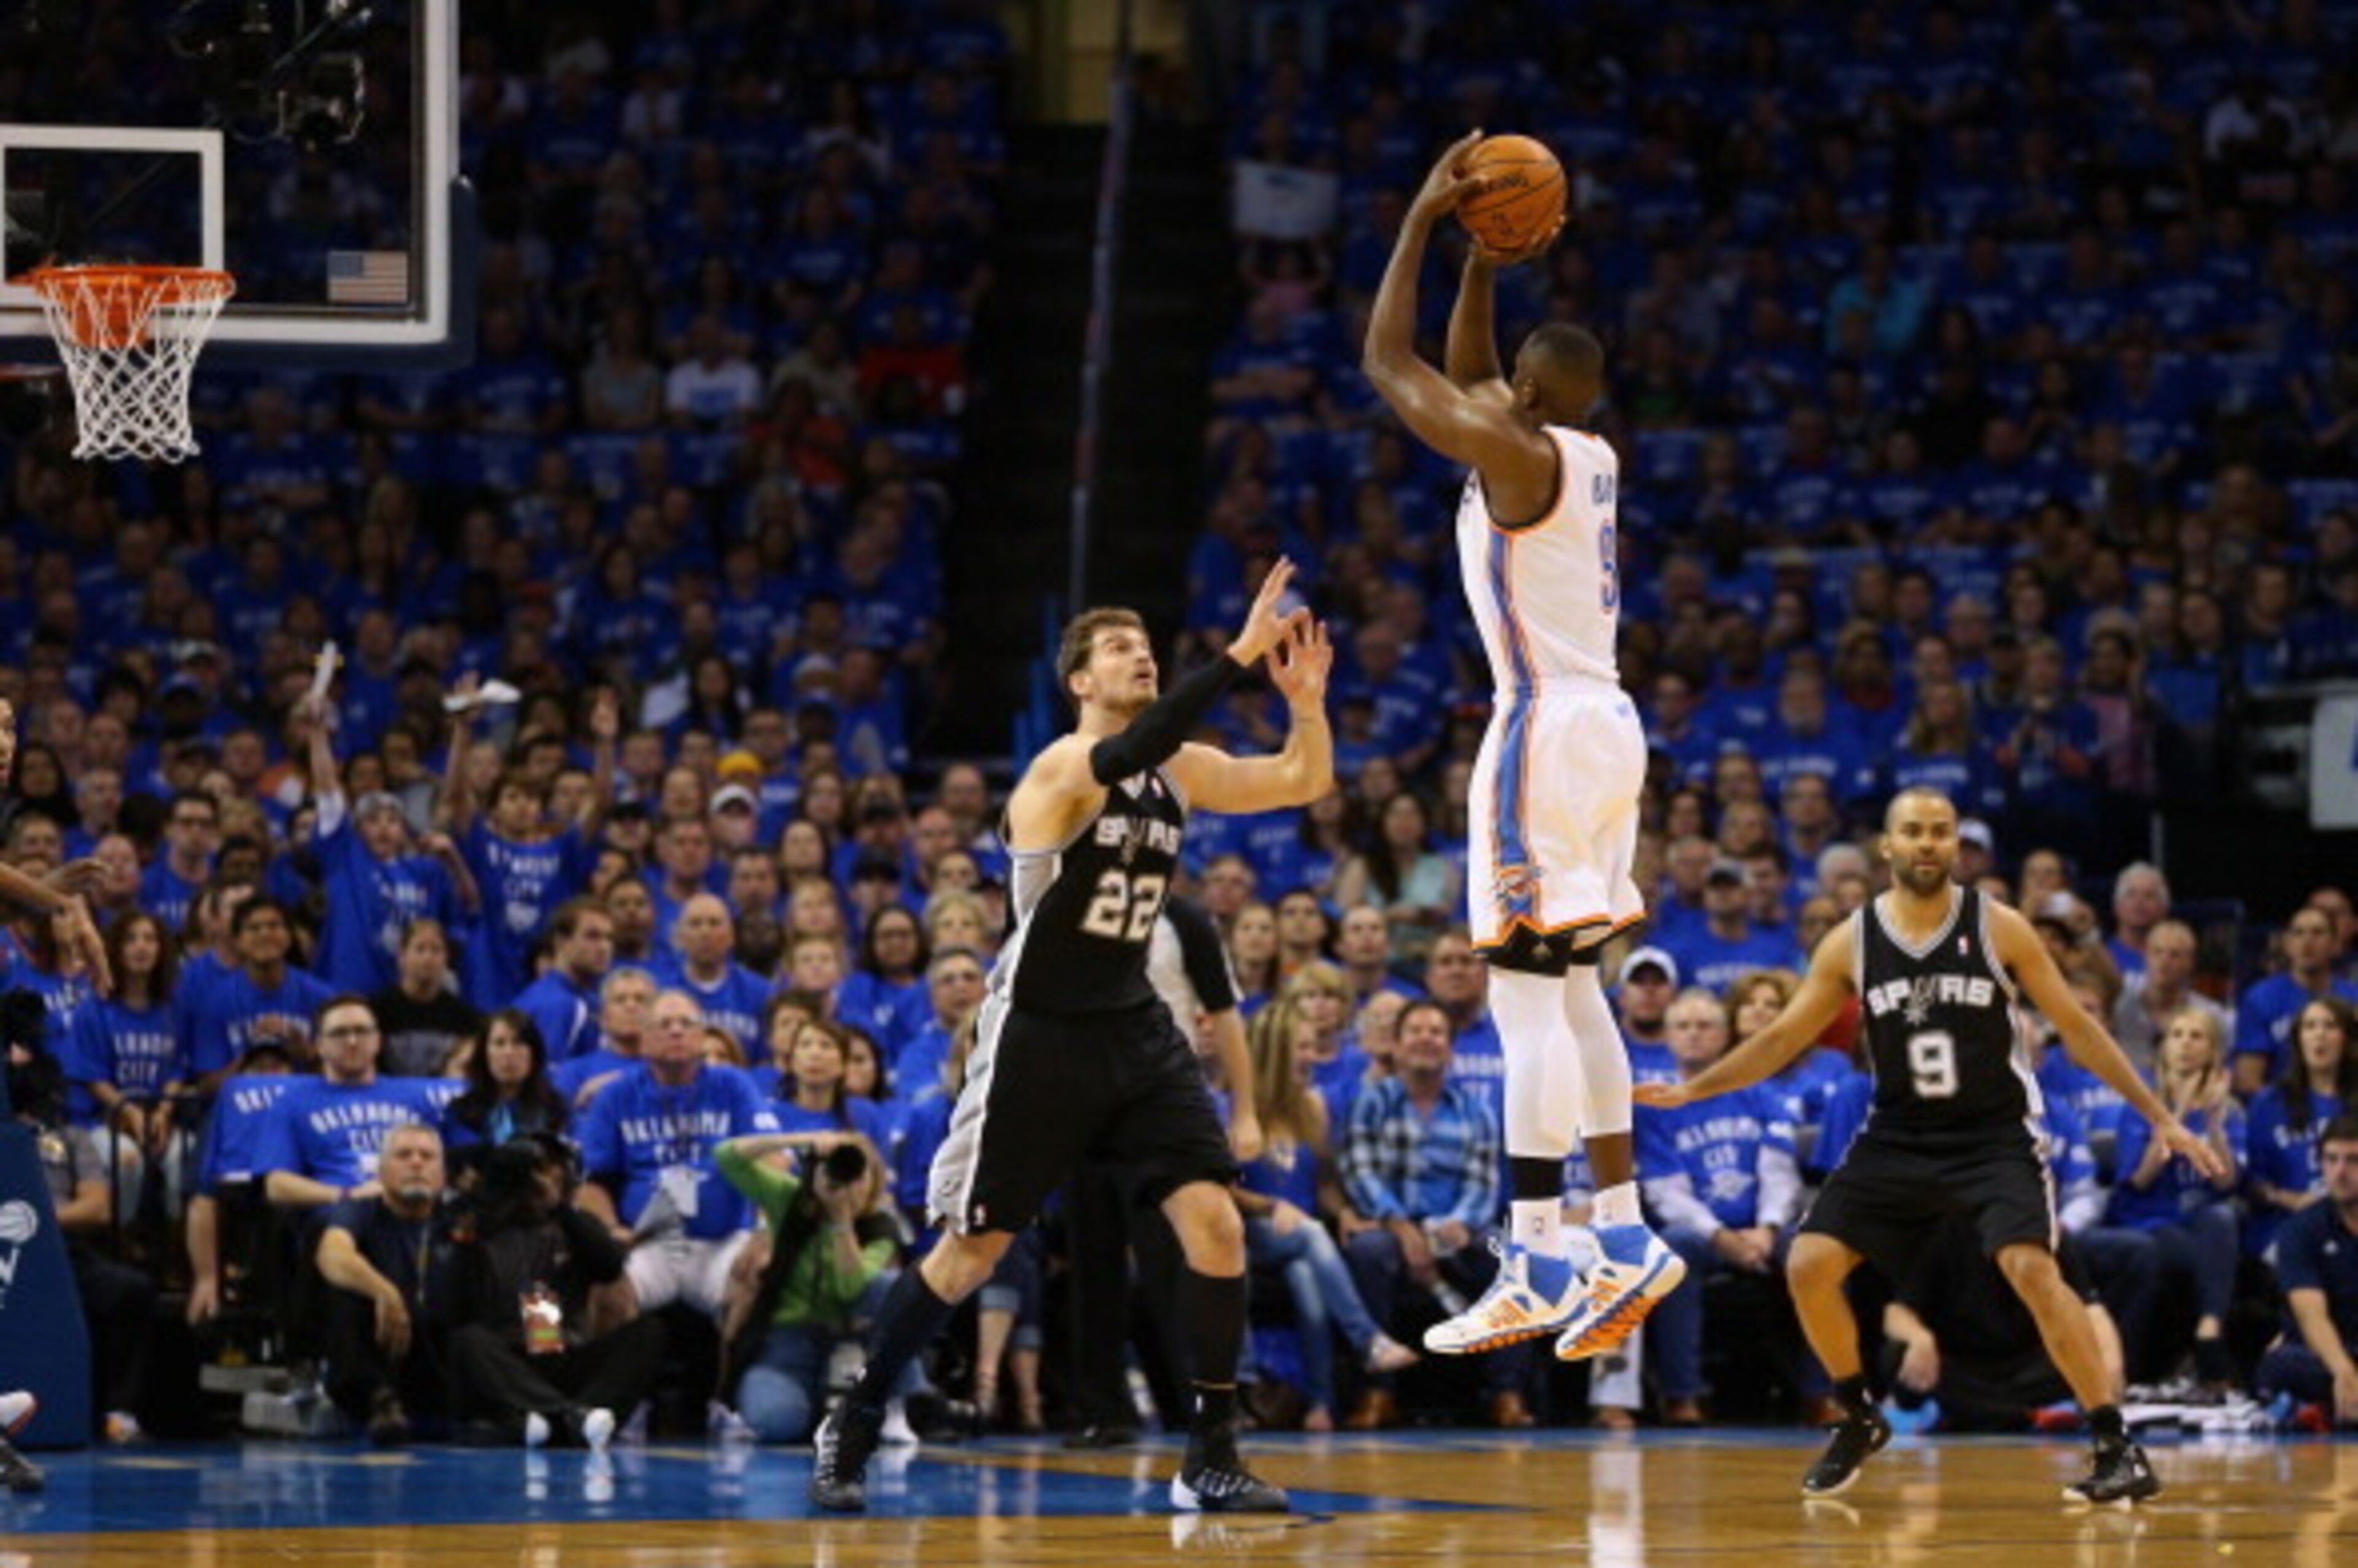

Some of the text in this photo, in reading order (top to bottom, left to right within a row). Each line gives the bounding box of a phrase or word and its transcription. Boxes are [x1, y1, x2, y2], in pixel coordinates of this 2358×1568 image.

[1095, 815, 1181, 861] SPURS
[1079, 871, 1165, 940] 22
[1867, 971, 1995, 1024] SPURS
[1908, 1030, 1957, 1098] 9
